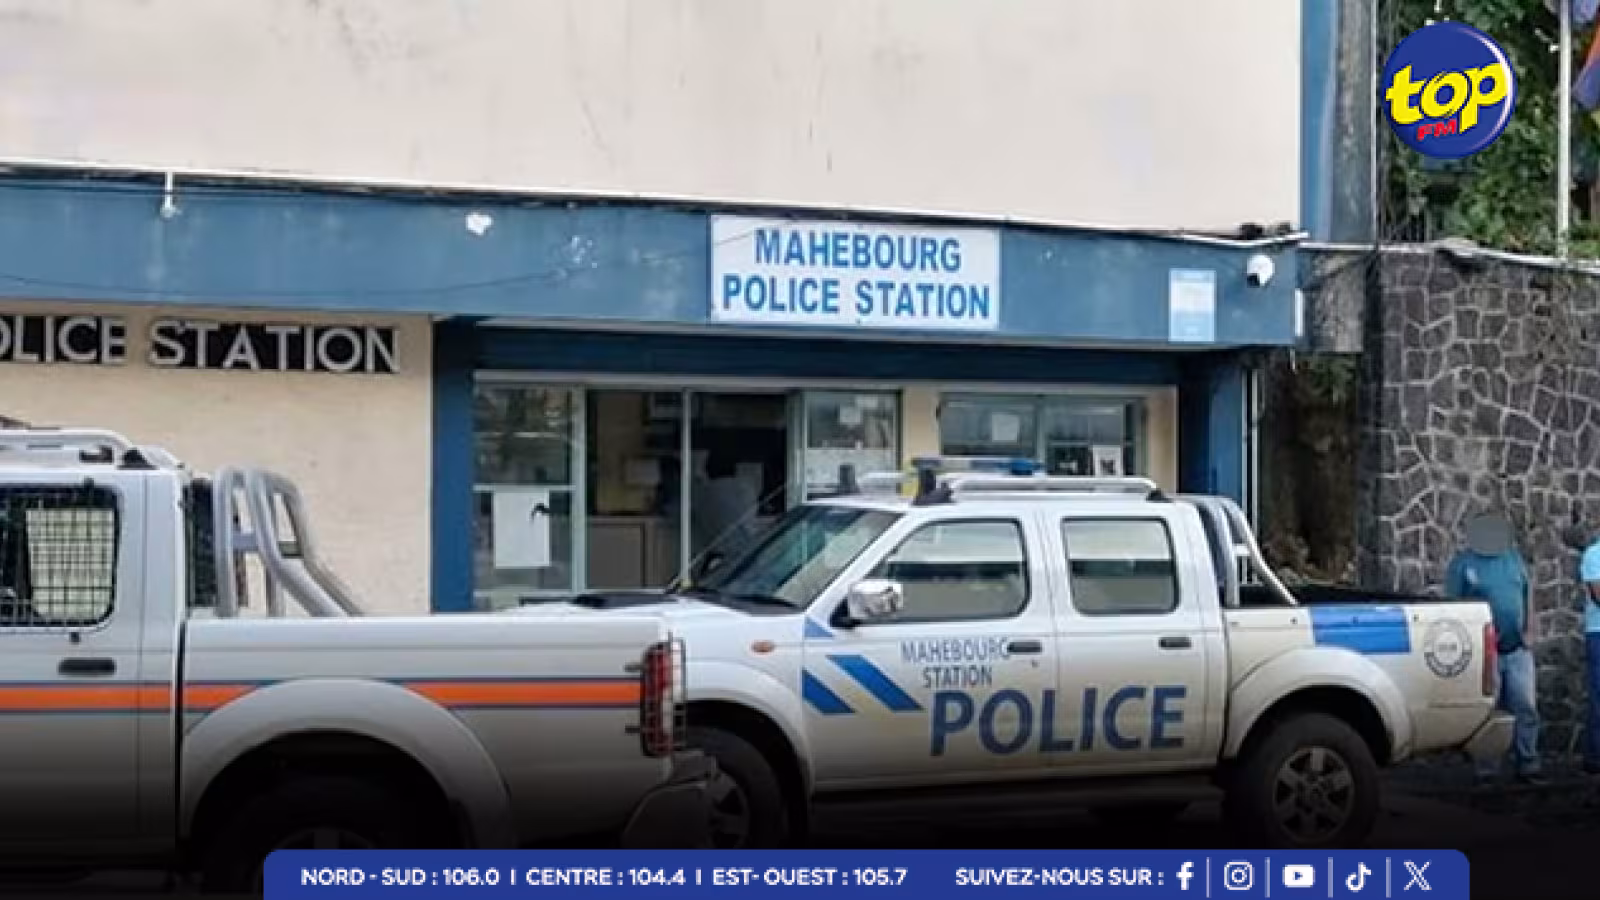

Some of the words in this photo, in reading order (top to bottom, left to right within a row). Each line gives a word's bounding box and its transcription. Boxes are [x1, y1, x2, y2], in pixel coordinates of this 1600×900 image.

[754, 229, 962, 273] MAHEBOURG
[722, 273, 840, 314] POLICE
[855, 279, 990, 319] STATION
[0, 315, 128, 364] LICE
[149, 320, 400, 374] STATION
[922, 664, 993, 689] STATION
[930, 685, 1187, 757] POLICE
